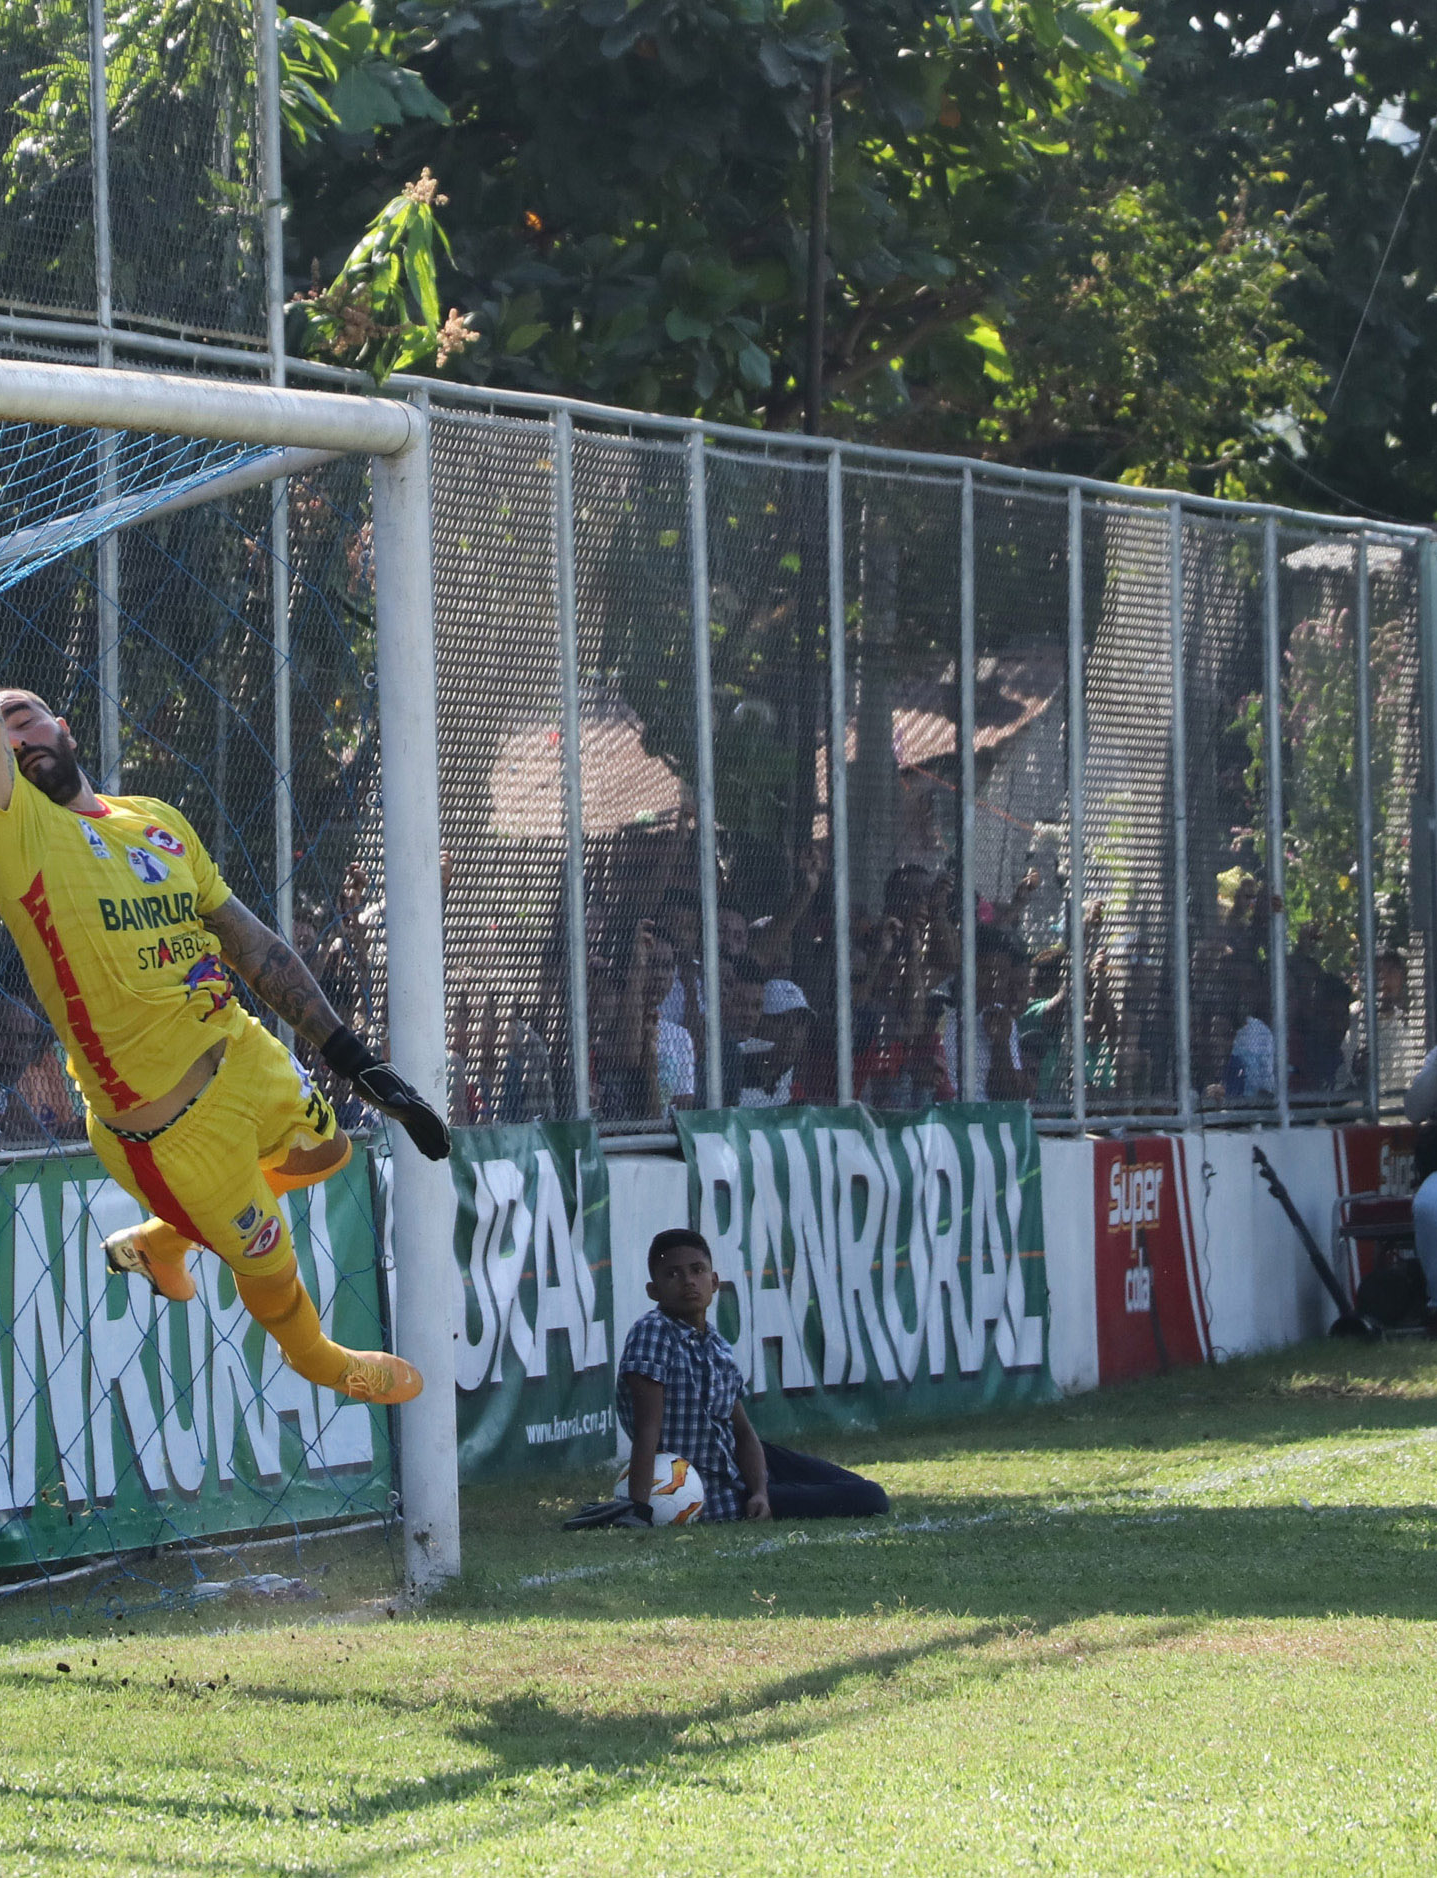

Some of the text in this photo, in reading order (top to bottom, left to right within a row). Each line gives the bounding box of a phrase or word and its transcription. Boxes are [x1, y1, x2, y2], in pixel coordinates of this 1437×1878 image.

[98, 892, 199, 931] BANRUR
[1108, 1159, 1164, 1251] Super
[693, 1121, 1044, 1393] BANRURAL
